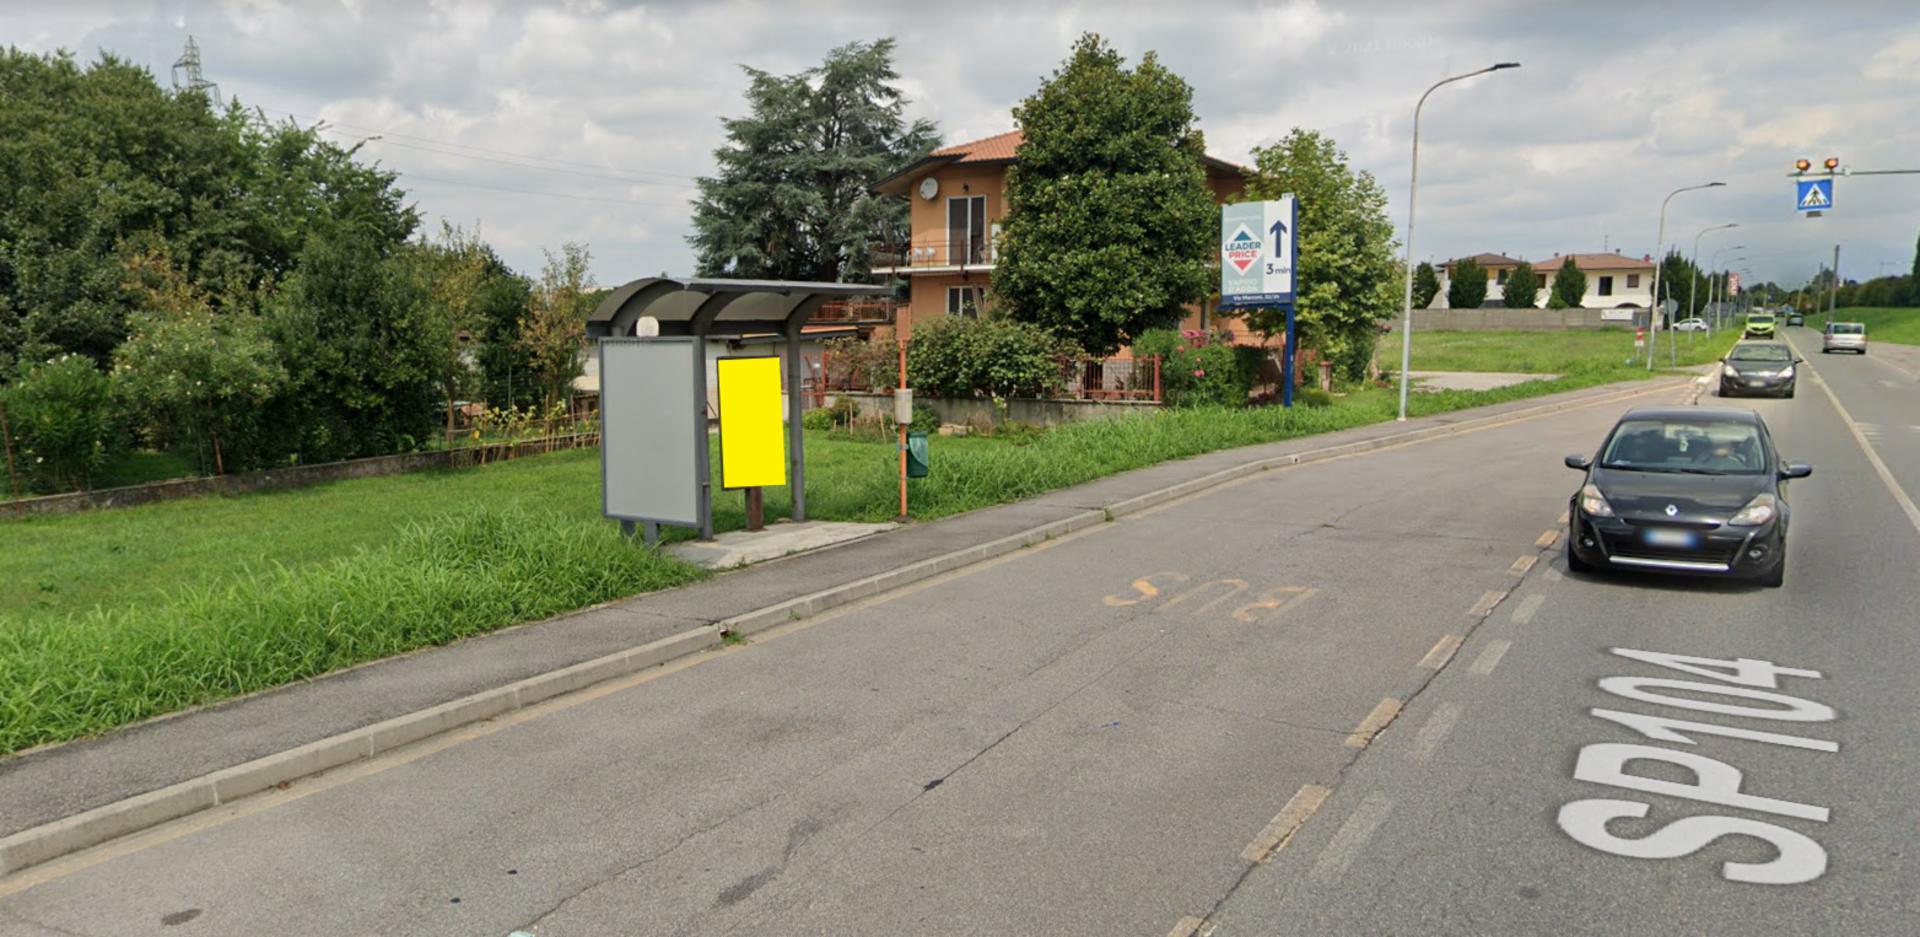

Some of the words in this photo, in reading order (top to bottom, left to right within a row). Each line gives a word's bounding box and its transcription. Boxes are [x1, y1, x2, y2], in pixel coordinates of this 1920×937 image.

[1225, 242, 1261, 251] LEADER
[1228, 251, 1257, 259] PRICE
[1266, 263, 1274, 275] 3
[1275, 266, 1291, 275] min
[1104, 571, 1321, 622] BUS
[1557, 647, 1840, 885] SP104
